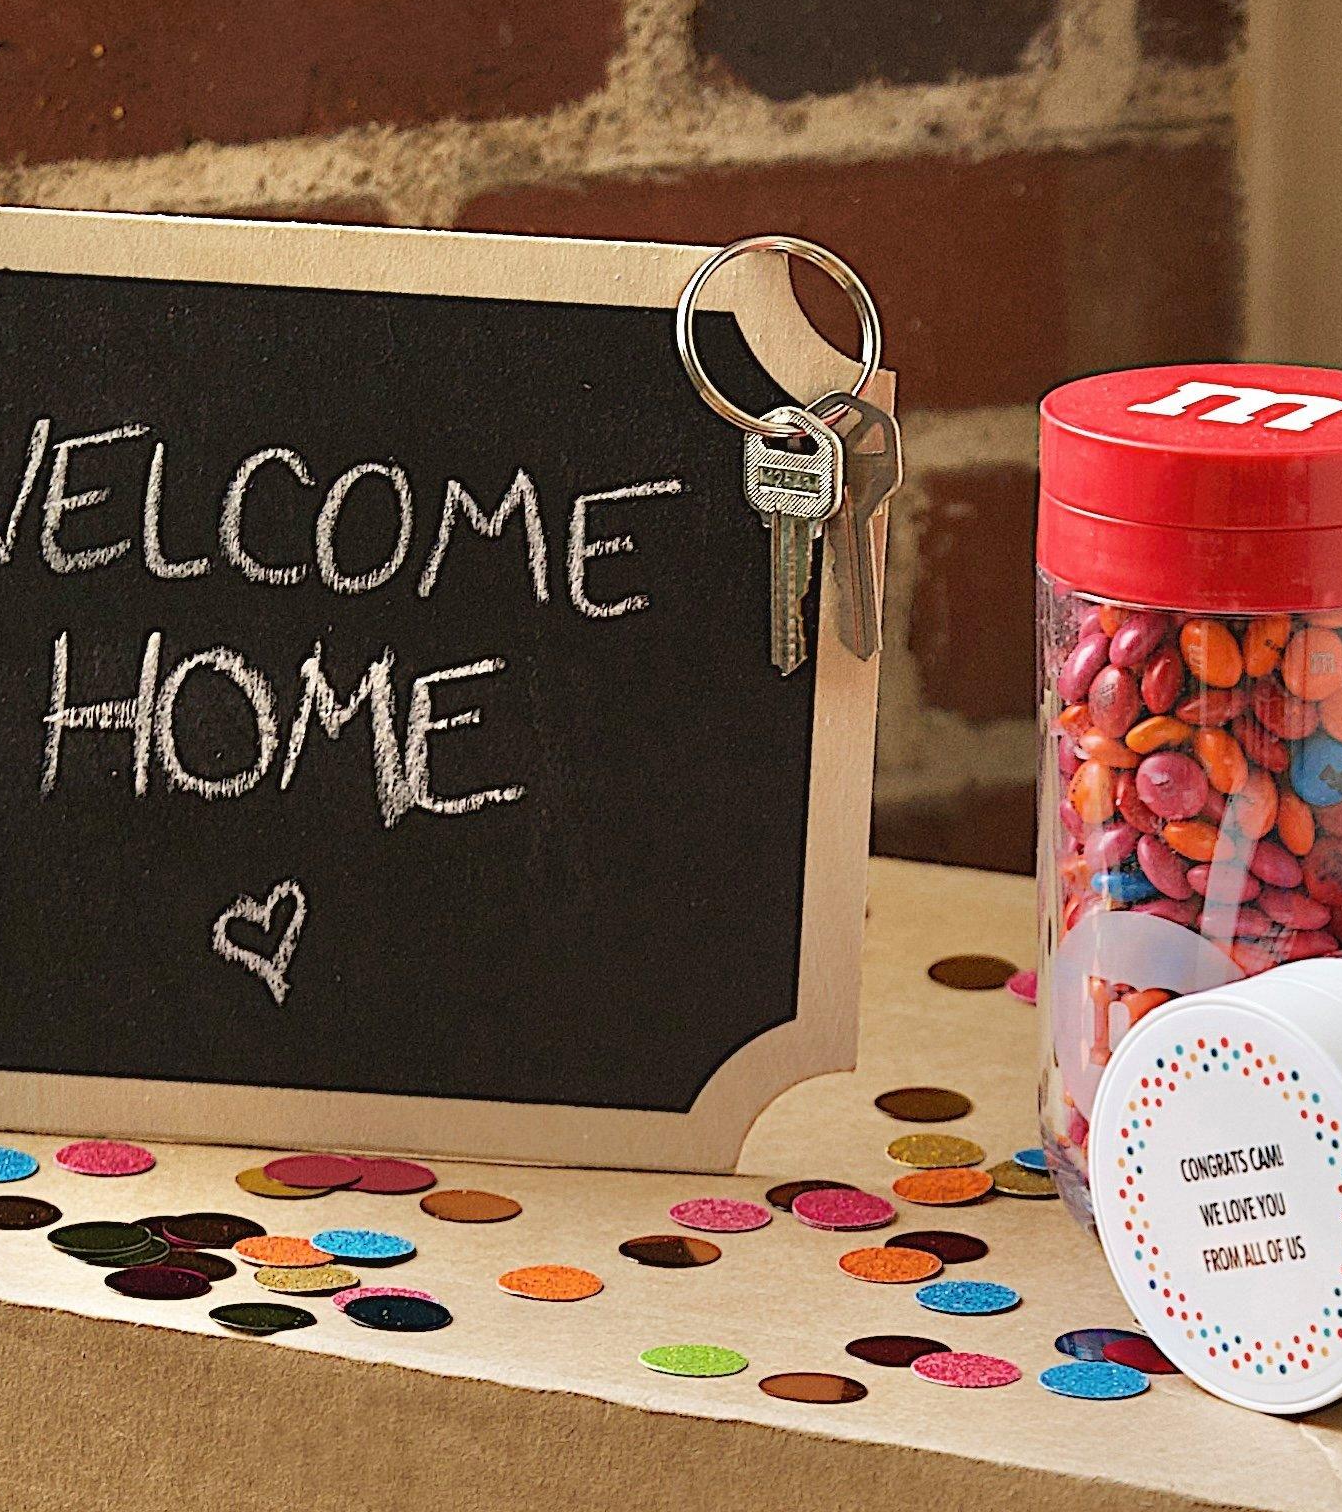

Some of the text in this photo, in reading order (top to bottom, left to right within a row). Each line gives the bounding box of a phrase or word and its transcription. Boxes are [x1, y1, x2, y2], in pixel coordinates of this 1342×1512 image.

[40, 630, 527, 830] HOME
[1180, 1144, 1284, 1182] CONGRATS CAM!
[1199, 1192, 1287, 1227] WE LOVE YOU
[1203, 1235, 1306, 1273] FROM ALL OF US
